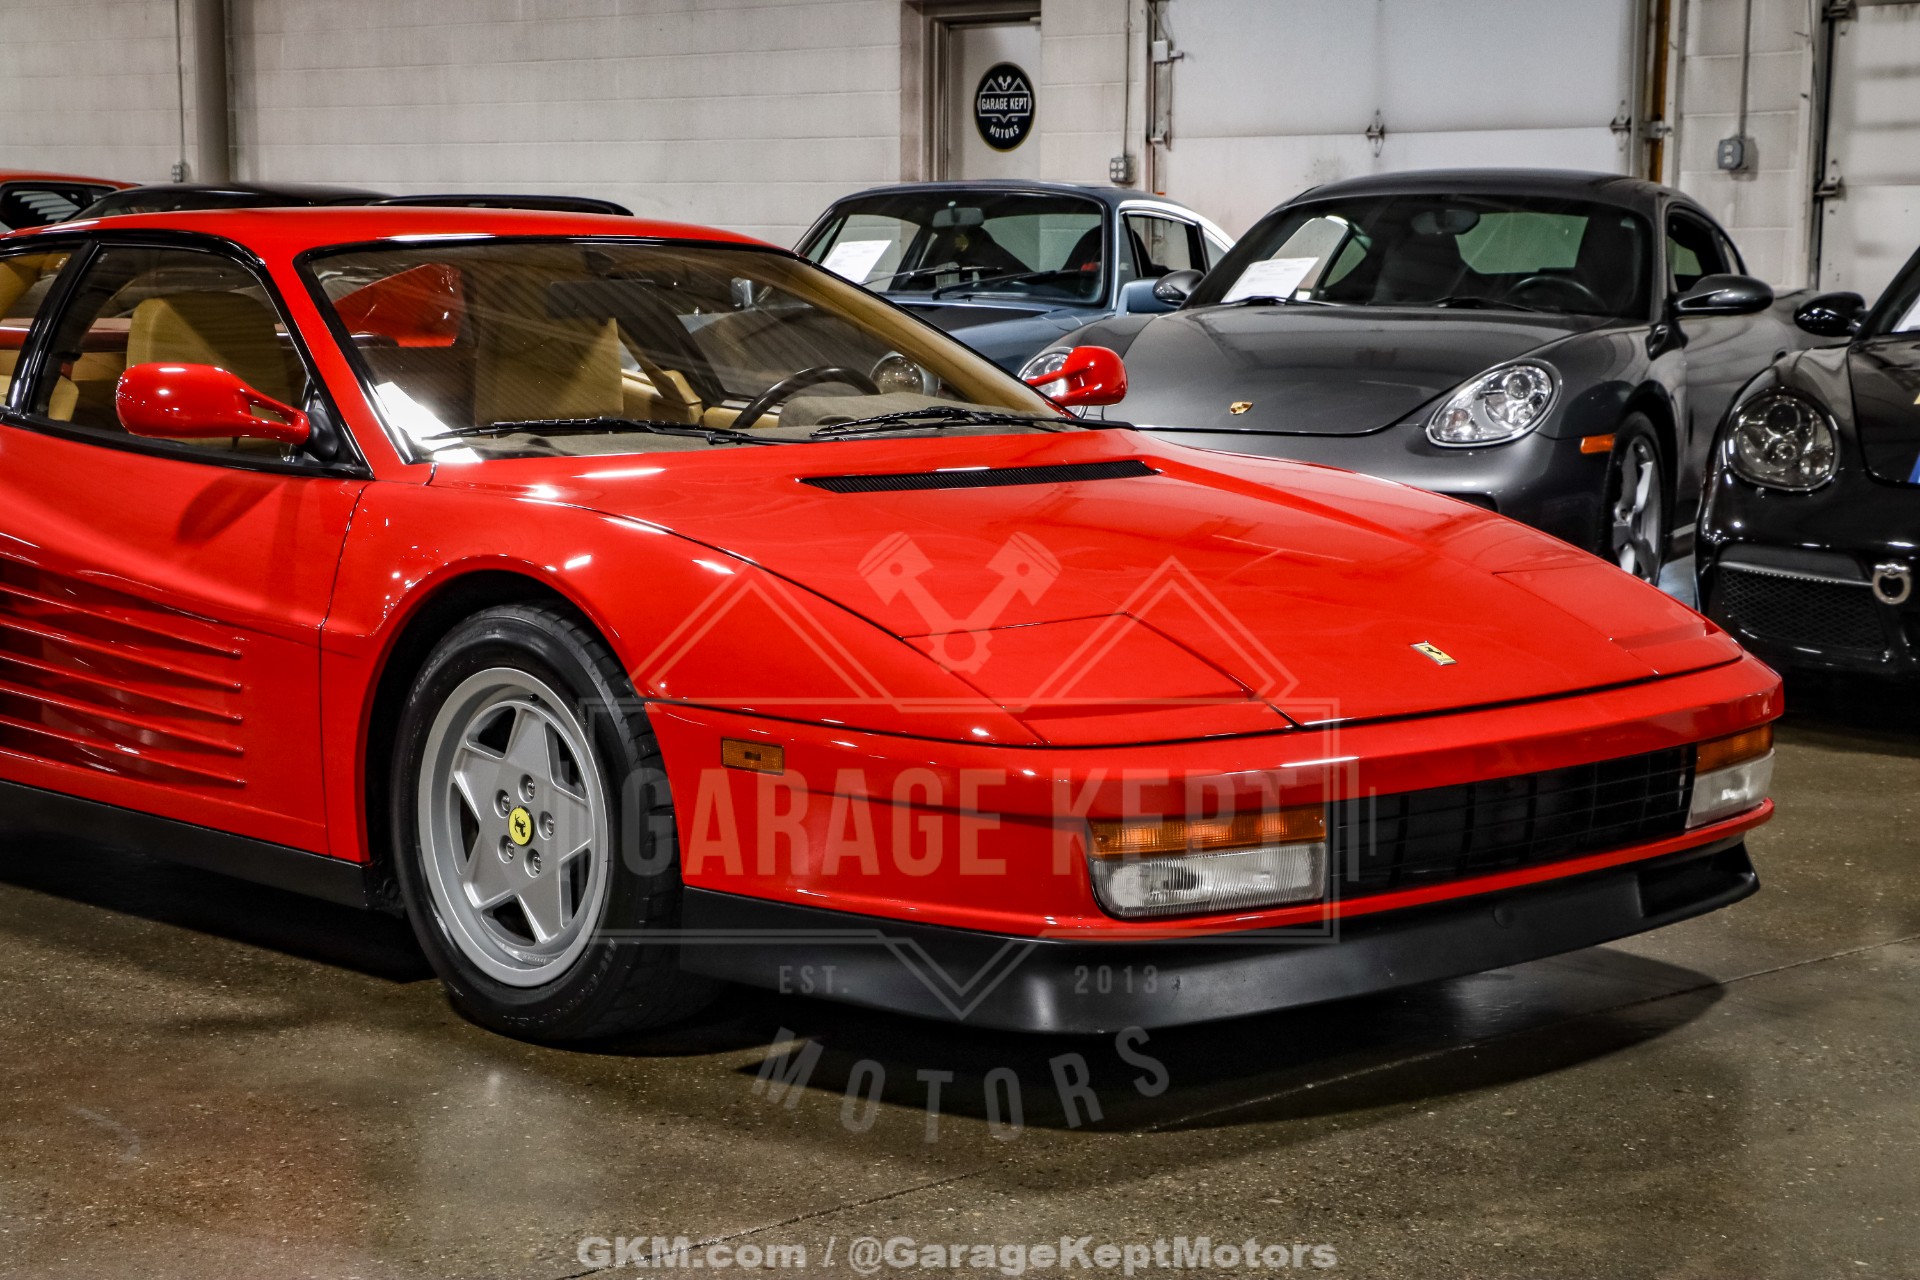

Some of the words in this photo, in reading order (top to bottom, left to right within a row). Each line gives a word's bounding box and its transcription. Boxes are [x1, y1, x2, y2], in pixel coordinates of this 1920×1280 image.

[981, 98, 1008, 110] GARAGE
[1010, 97, 1028, 110] KEPT
[989, 125, 1020, 139] MOTORS
